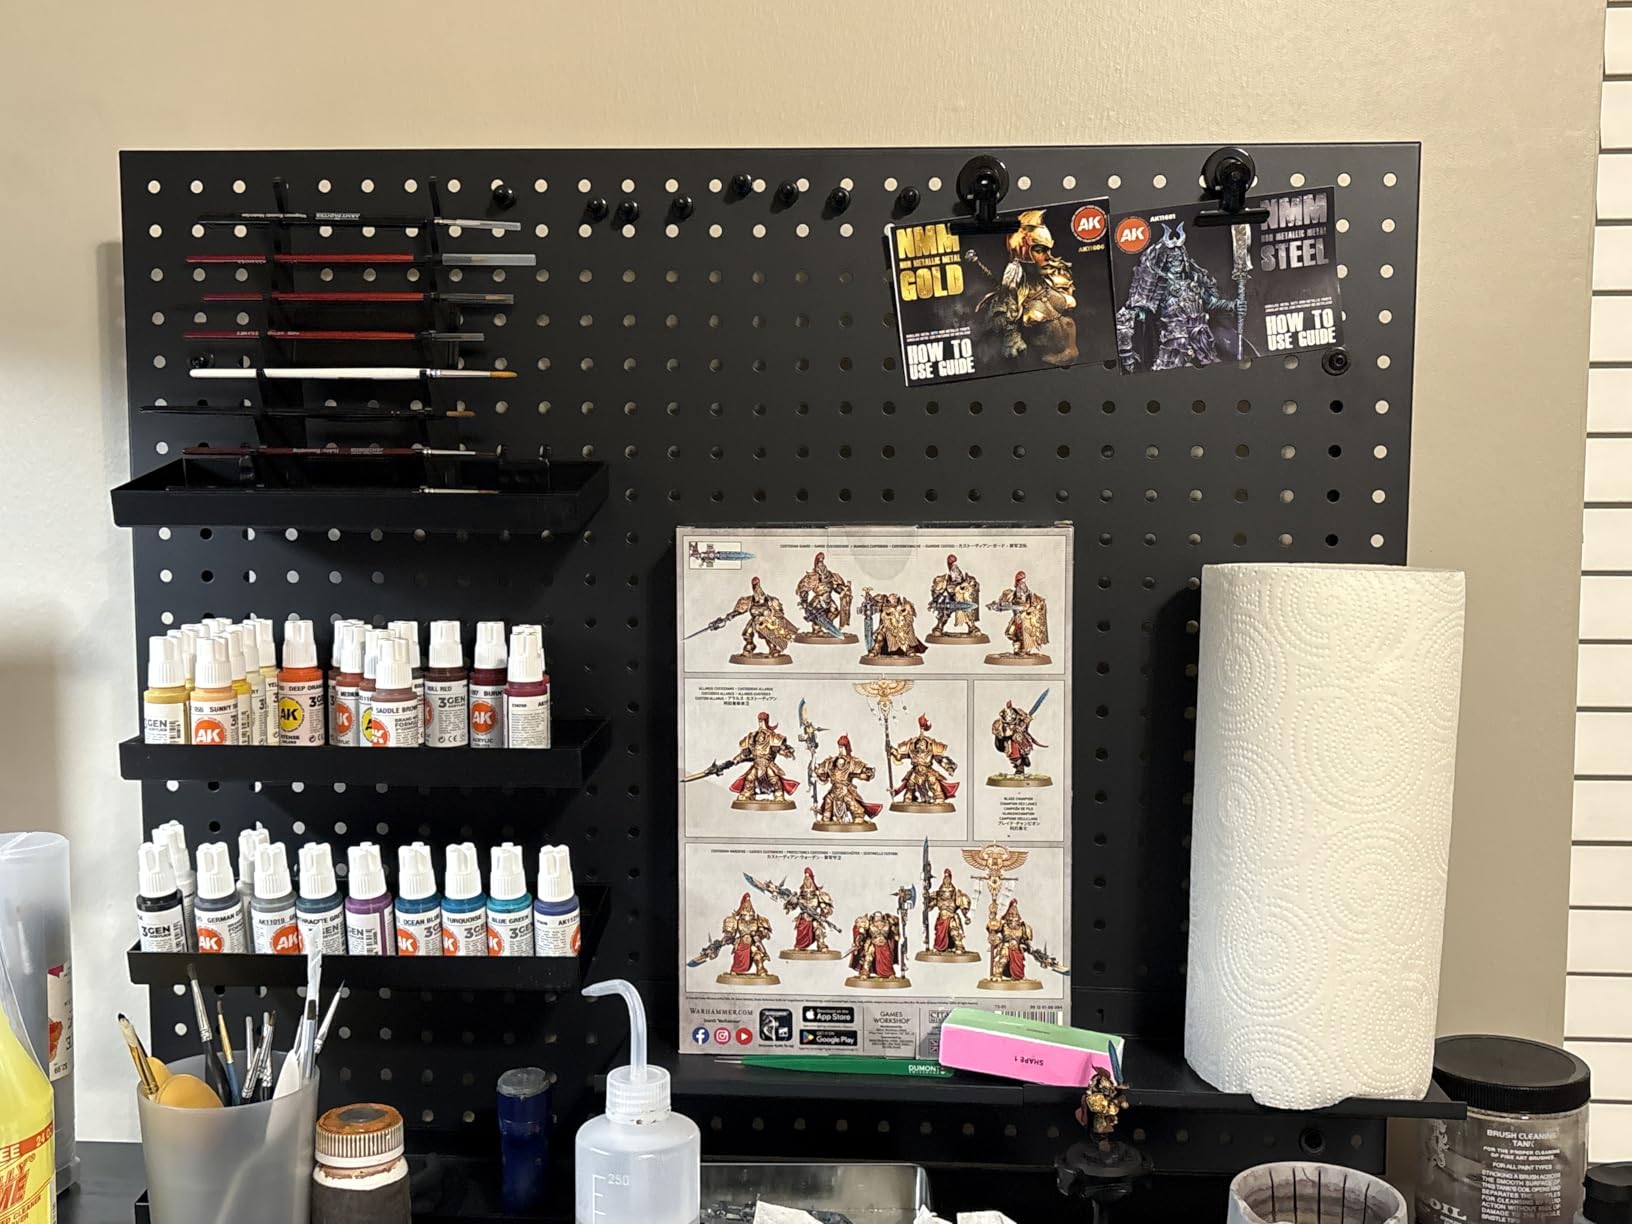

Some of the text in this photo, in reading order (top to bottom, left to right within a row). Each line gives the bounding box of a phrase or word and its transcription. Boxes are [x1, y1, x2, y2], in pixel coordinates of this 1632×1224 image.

[1260, 192, 1327, 230] NMM
[1078, 216, 1102, 231] AK
[896, 223, 960, 258] NMM
[1121, 227, 1145, 242] AK
[1261, 238, 1329, 272] STEEL
[900, 263, 964, 302] GOLD
[1265, 308, 1334, 336] HOW TO
[1267, 326, 1336, 351] USE GUIDE
[906, 338, 972, 365] HOW TO
[909, 356, 975, 380] USE GUIDE
[209, 705, 231, 713] SUNNY
[281, 708, 298, 721] AK
[472, 711, 493, 725] AK
[197, 728, 222, 743] AK
[207, 913, 235, 923] GERMAN
[141, 925, 171, 937] 3GEN
[816, 1013, 851, 1021] App Store
[816, 1036, 855, 1044] Google Play
[1019, 1056, 1044, 1066] SHAPE
[1486, 1129, 1517, 1139] BRUSH
[1512, 1140, 1535, 1148] TANK
[608, 1173, 629, 1186] 250
[1481, 1169, 1513, 1178] STROKING
[1481, 1175, 1495, 1183] THE
[1496, 1177, 1524, 1186] SMOOTH
[1481, 1181, 1496, 1189] THIS
[1481, 1188, 1519, 1198] SEPARATES
[1481, 1194, 1496, 1202] FOR
[1481, 1201, 1506, 1210] ACTION
